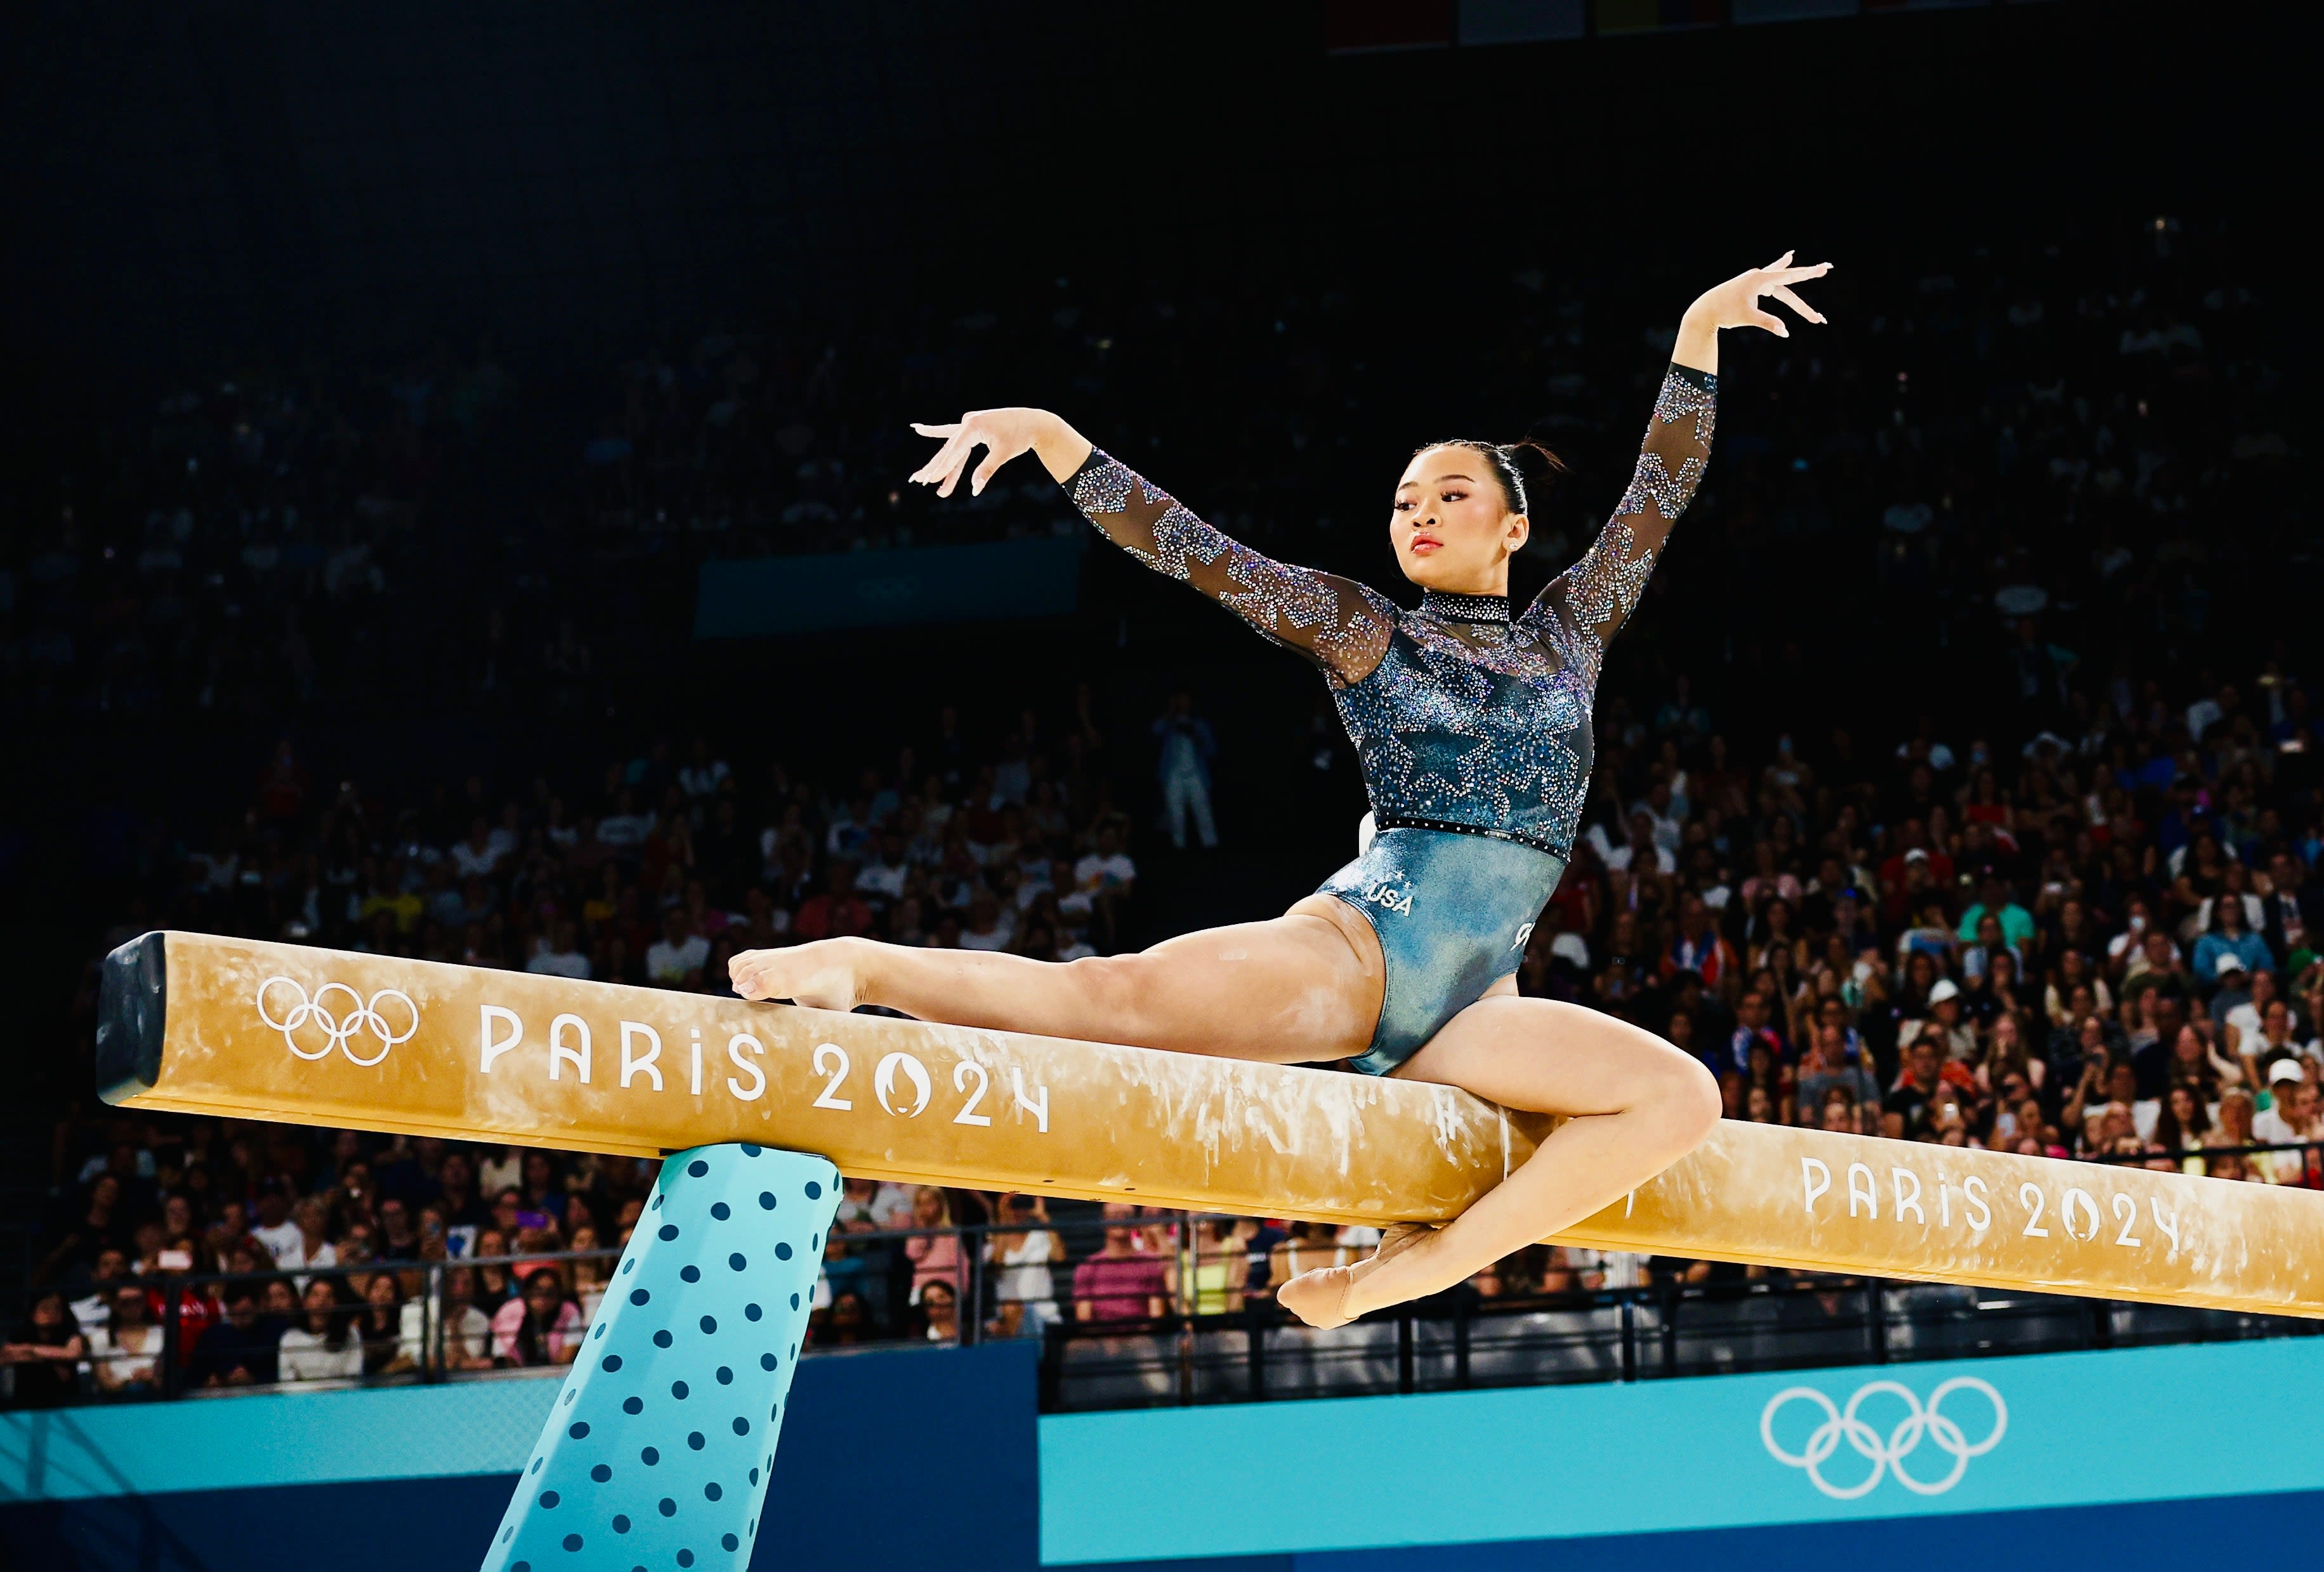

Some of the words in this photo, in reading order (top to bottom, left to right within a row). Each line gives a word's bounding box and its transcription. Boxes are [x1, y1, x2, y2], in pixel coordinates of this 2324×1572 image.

[1367, 882, 1414, 917] USA
[812, 1043, 1048, 1133] 2024
[2019, 1182, 2179, 1252] 2024
